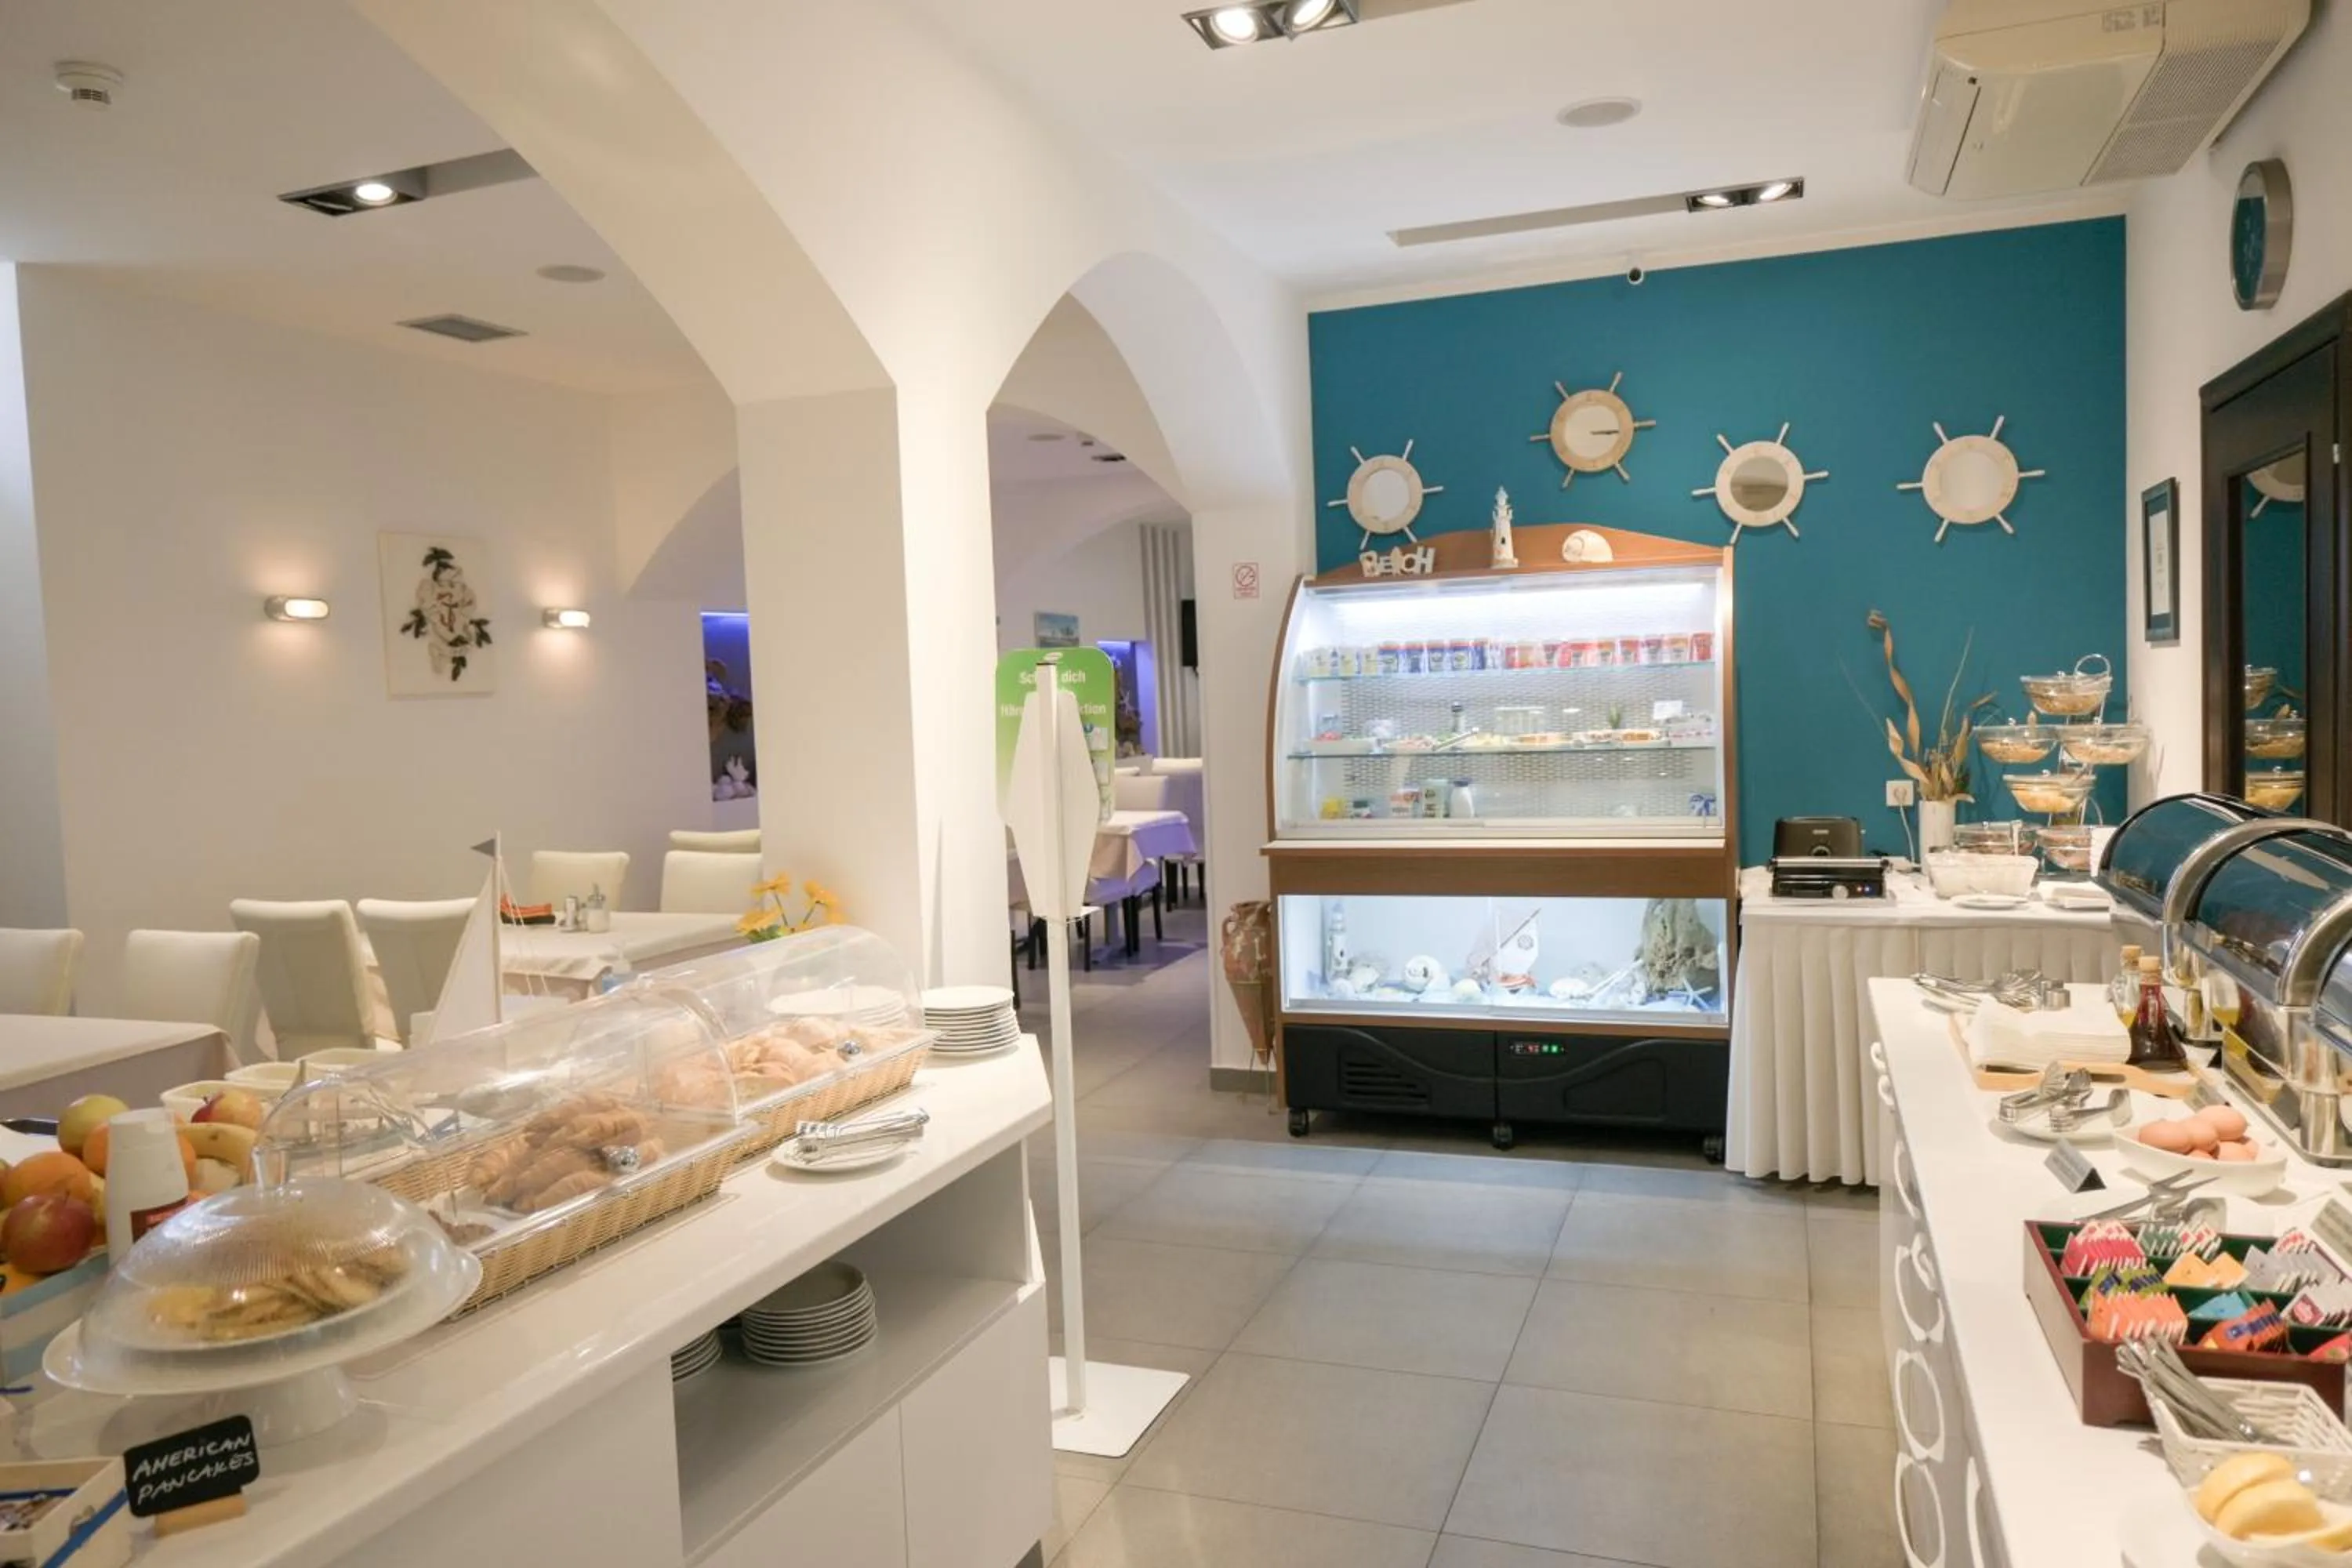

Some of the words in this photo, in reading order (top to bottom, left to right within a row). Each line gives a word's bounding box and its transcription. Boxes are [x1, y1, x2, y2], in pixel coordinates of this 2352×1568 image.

[1061, 670, 1086, 684] dich
[132, 1433, 250, 1481] AMERICAN
[137, 1451, 254, 1504] PANCAKES
